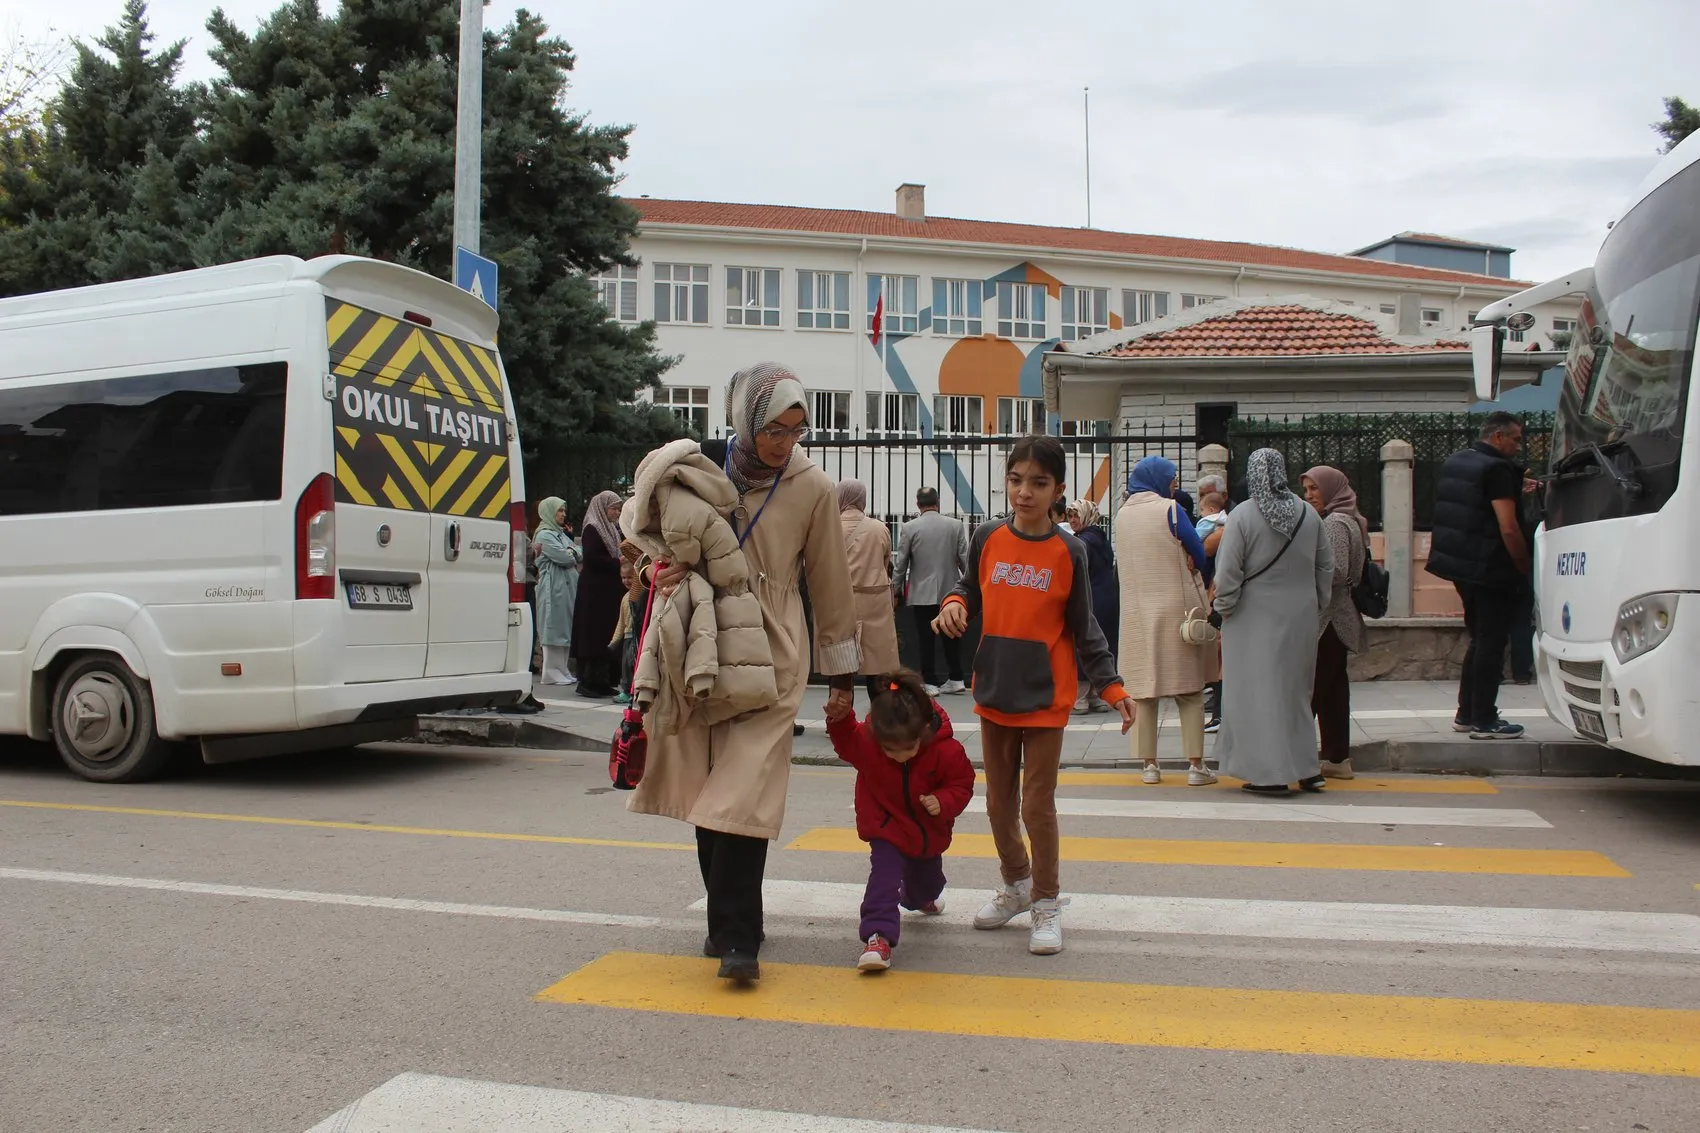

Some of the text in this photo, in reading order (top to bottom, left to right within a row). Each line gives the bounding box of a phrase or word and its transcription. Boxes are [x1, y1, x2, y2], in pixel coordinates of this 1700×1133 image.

[342, 385, 500, 447] OKUL TAŞITI
[1556, 552, 1586, 576] NEXTUR
[991, 562, 1052, 592] FSM
[205, 586, 264, 601] Göksel Doğan
[354, 585, 409, 603] 68 S 0439
